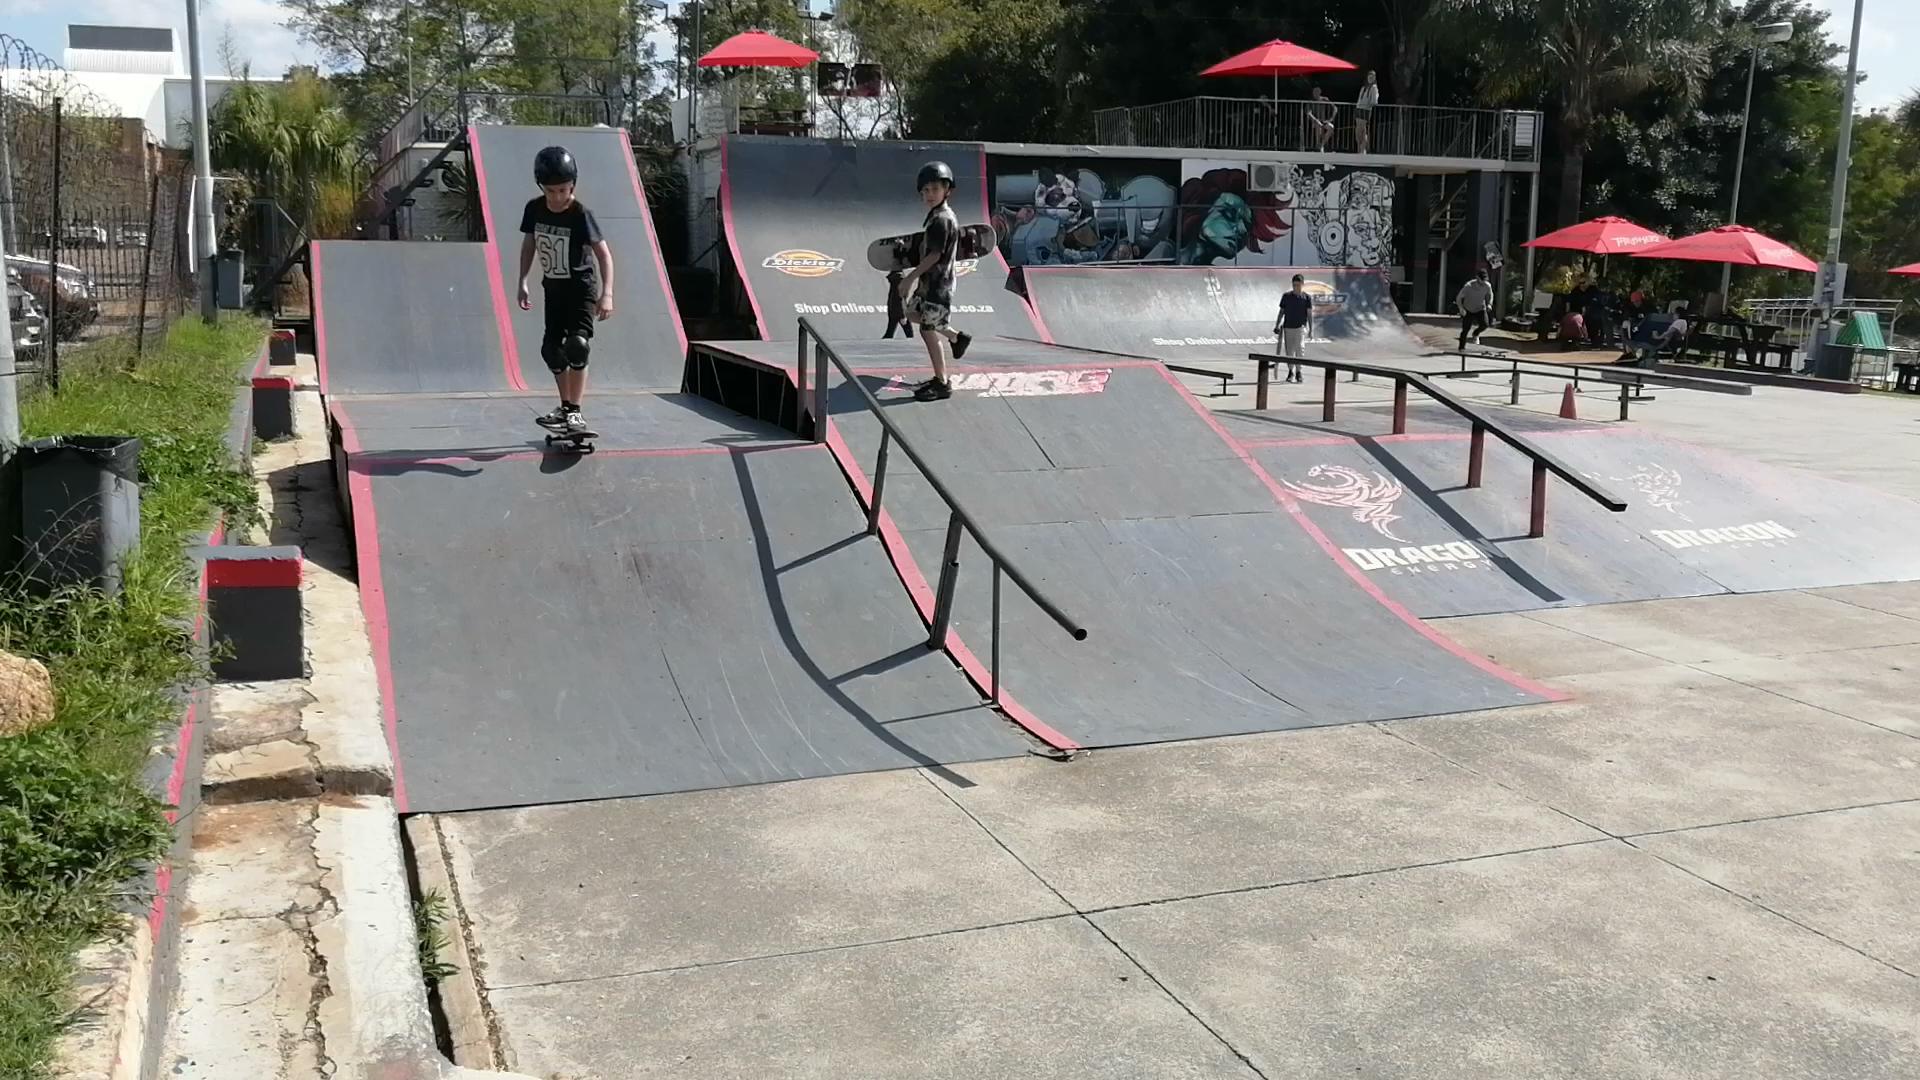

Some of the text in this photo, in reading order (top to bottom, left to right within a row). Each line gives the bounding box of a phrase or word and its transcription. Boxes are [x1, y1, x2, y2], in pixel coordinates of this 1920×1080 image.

[771, 258, 837, 267] Dickies
[794, 302, 829, 315] Shop
[831, 302, 874, 313] Online
[1650, 519, 1798, 549] DRAGON
